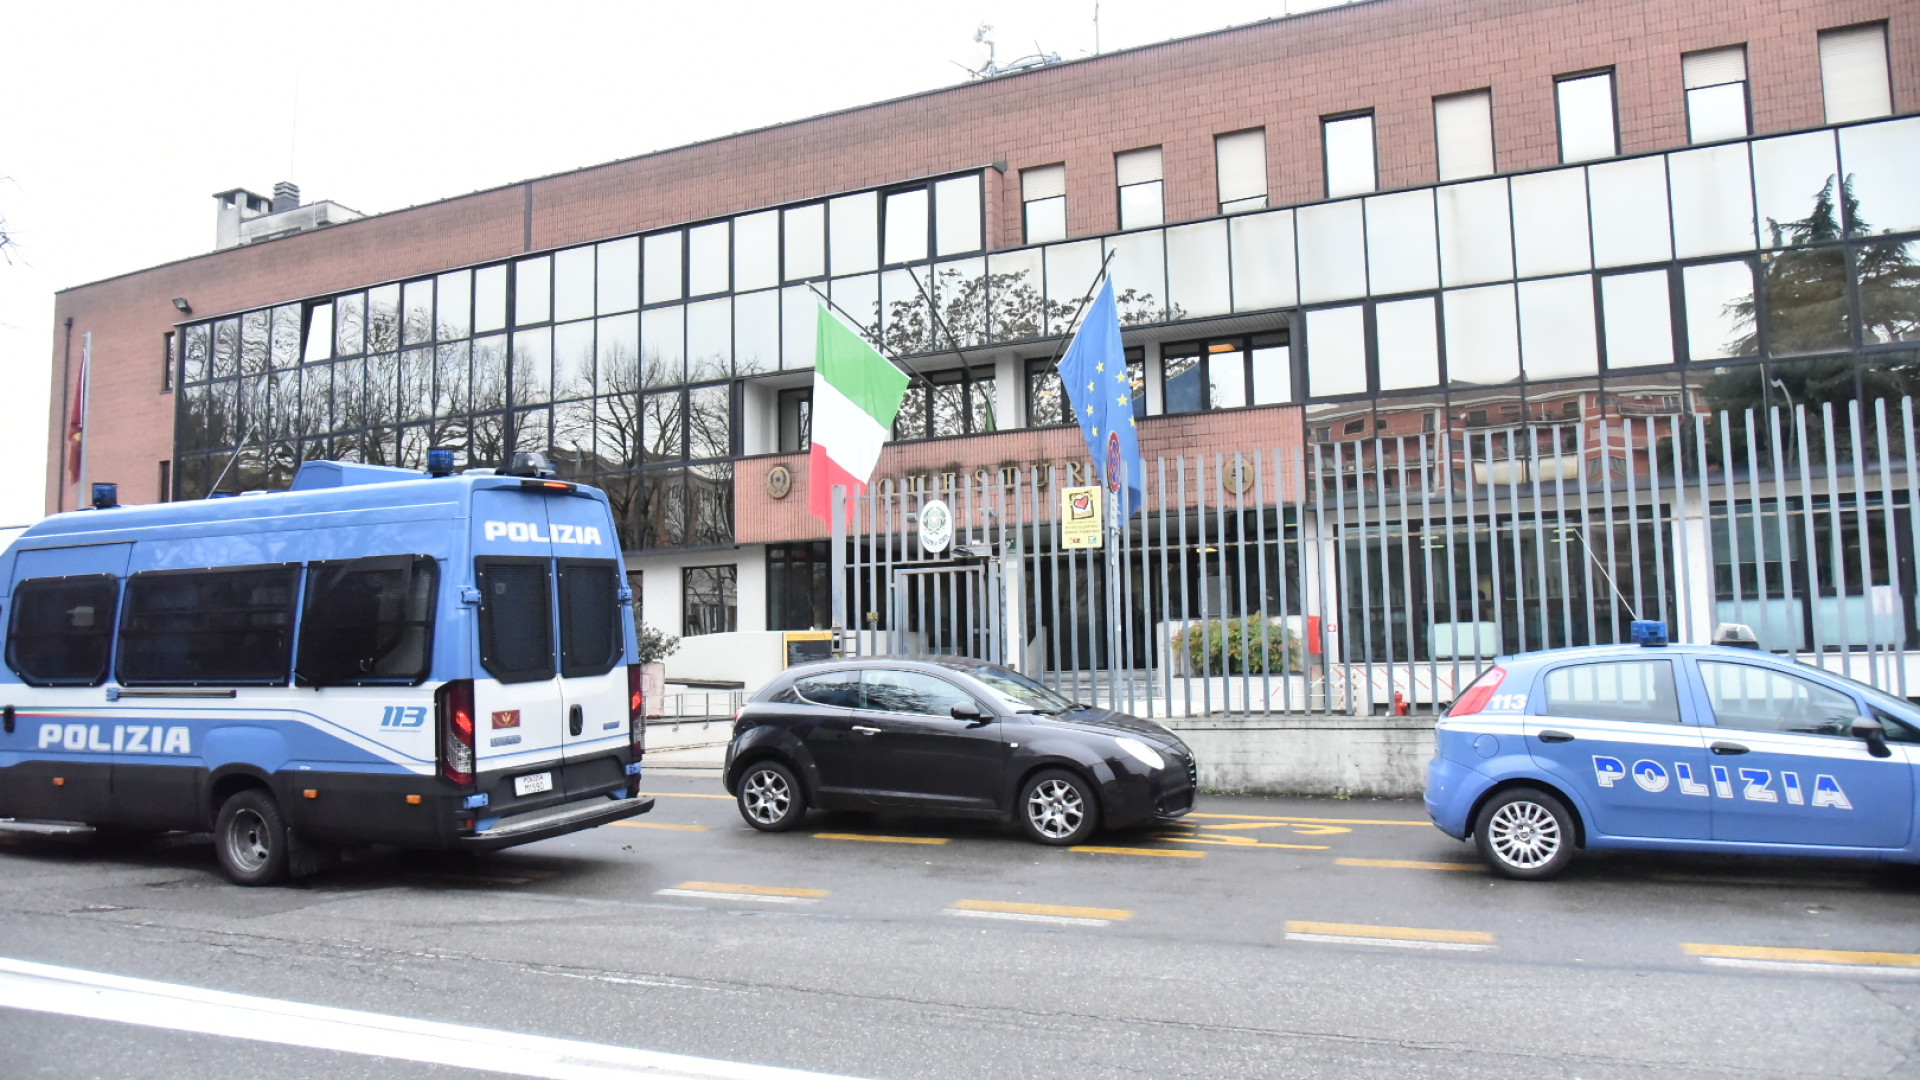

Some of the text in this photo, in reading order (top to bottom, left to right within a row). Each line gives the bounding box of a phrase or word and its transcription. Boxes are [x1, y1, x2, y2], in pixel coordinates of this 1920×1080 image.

[876, 460, 1102, 504] QUESTUR
[484, 520, 602, 546] POLIZIA
[1491, 694, 1528, 710] 113
[381, 706, 428, 728] 113
[38, 723, 191, 754] POLIZIA
[1591, 754, 1854, 810] POLIZIA
